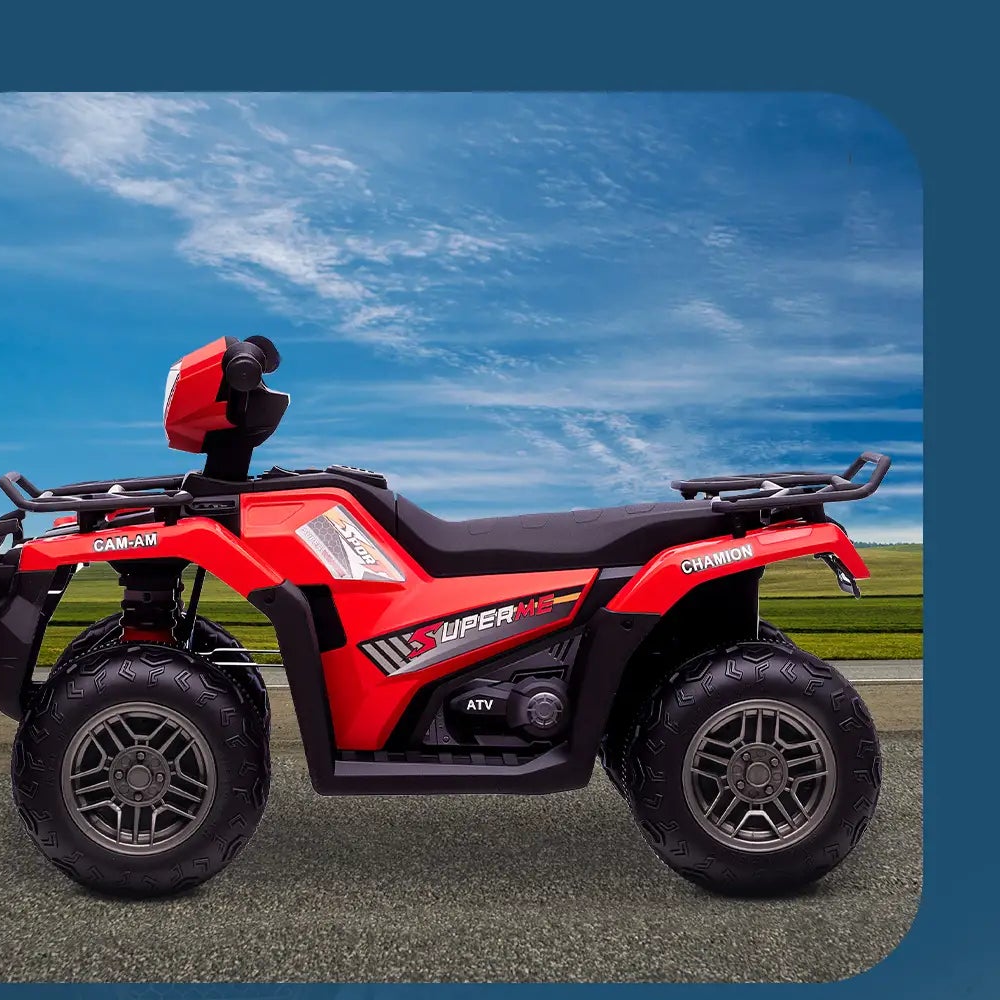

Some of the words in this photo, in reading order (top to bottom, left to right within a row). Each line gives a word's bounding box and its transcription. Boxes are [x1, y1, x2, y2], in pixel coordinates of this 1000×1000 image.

[93, 533, 157, 552] CAM-AM
[681, 543, 753, 574] CHAMION
[401, 594, 555, 662] SUPERME
[466, 699, 494, 711] ATV
